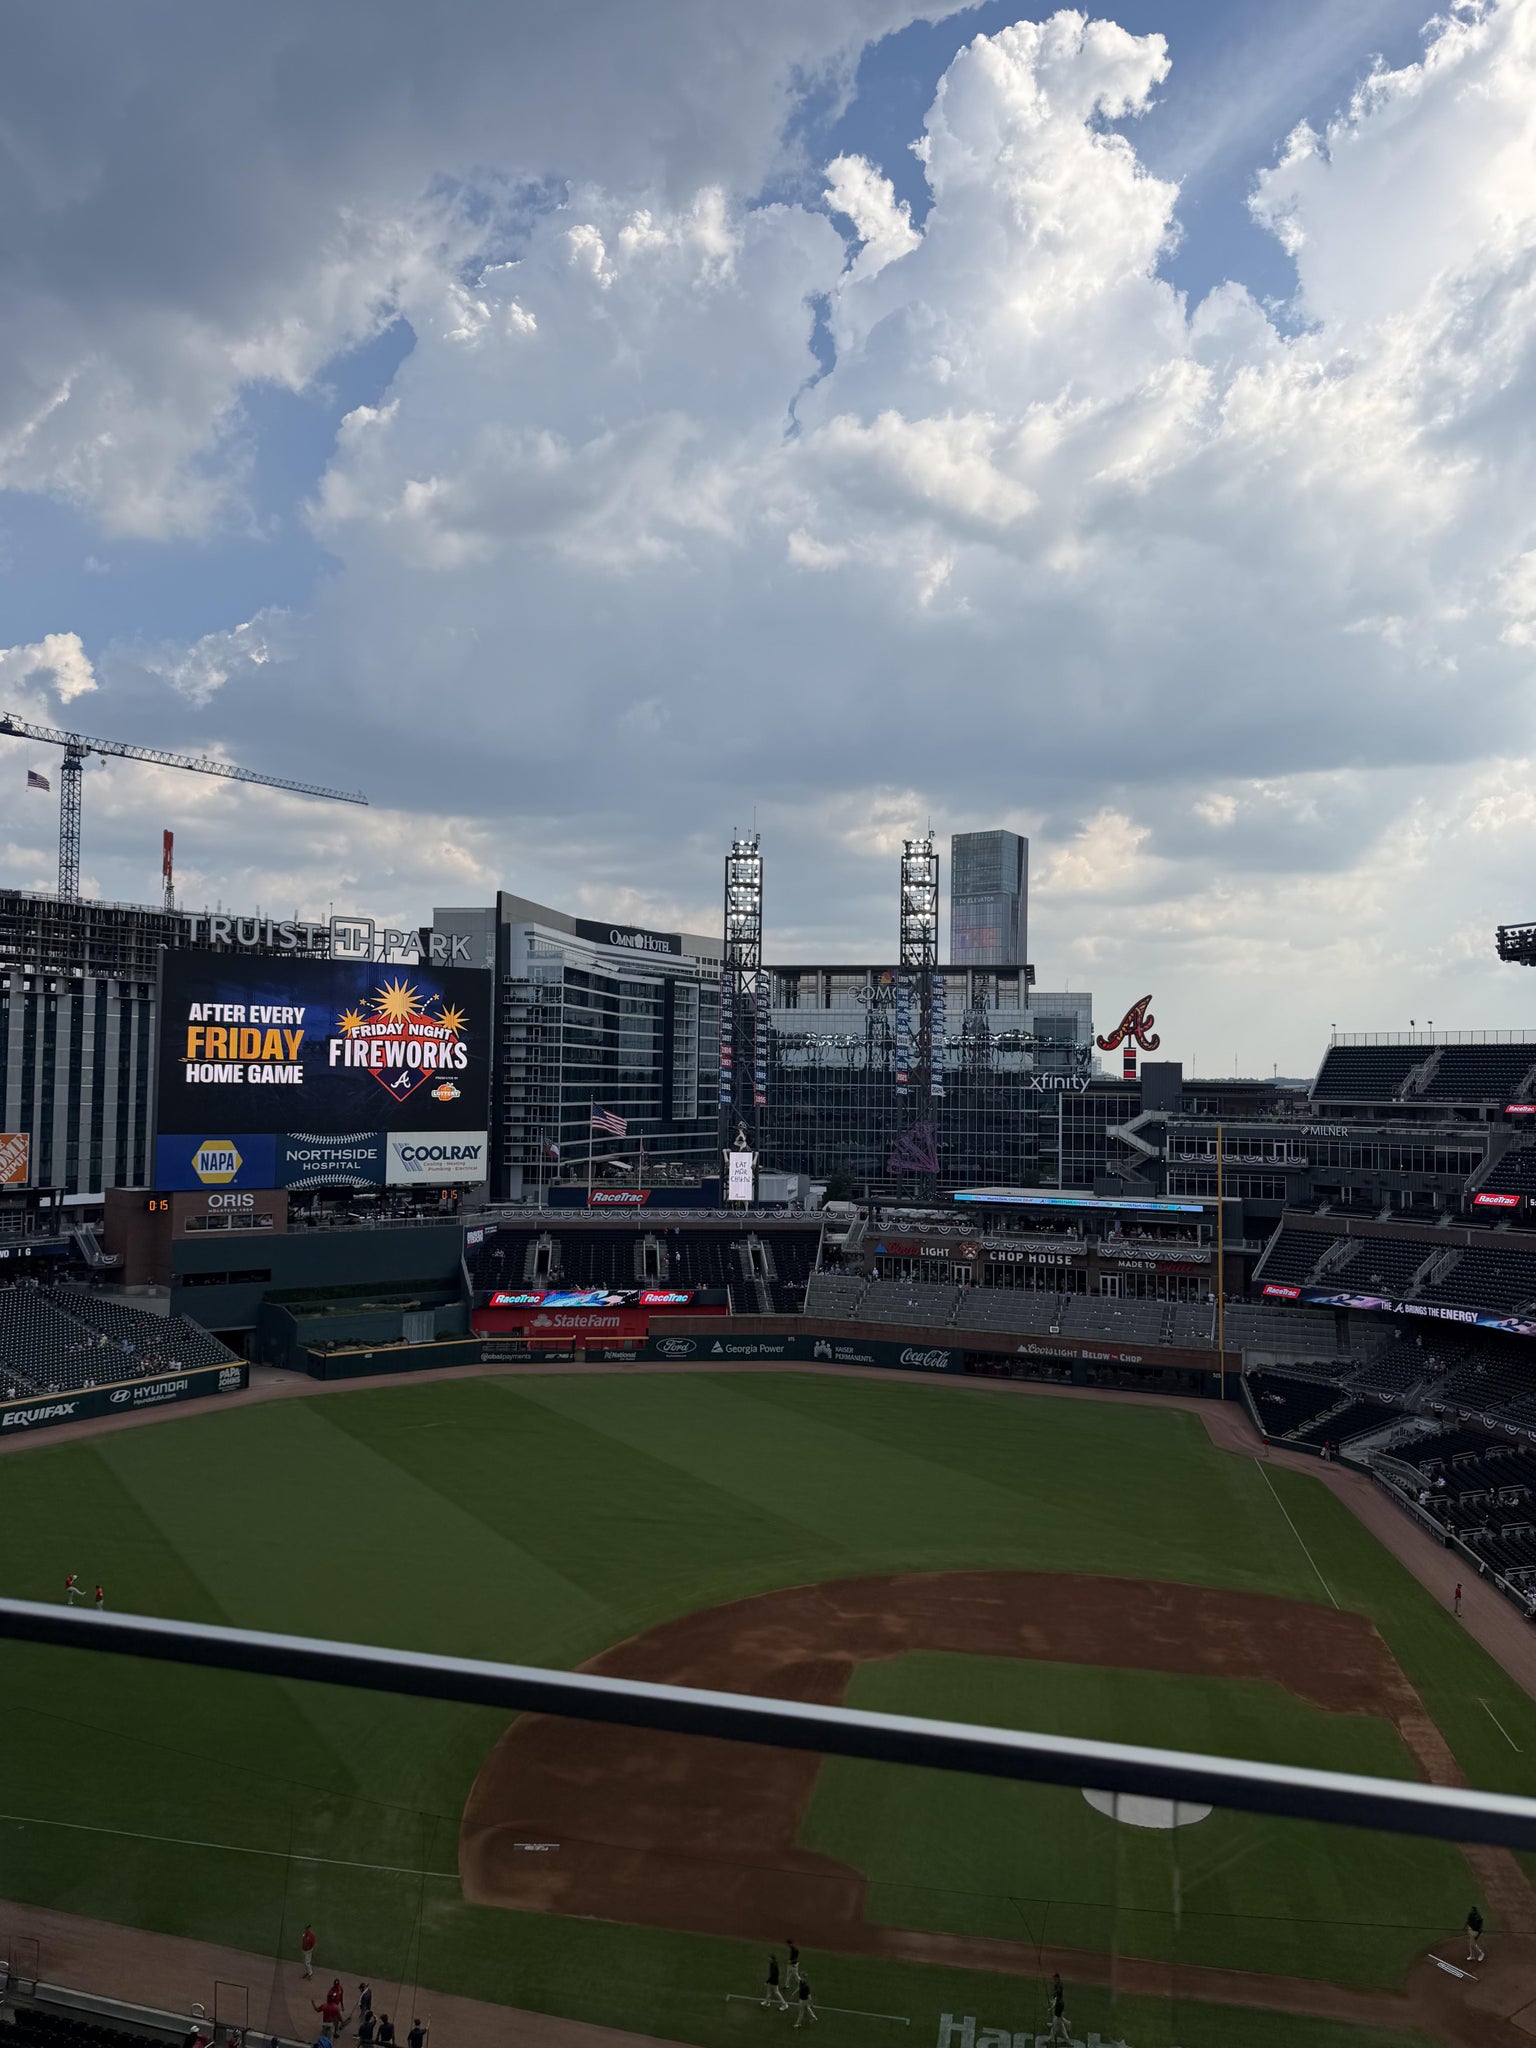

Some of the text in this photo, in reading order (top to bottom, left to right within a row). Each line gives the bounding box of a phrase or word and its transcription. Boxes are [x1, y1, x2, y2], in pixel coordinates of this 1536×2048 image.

[183, 914, 473, 961] TRUIST PARK
[644, 935, 671, 953] HOTEL
[189, 1003, 305, 1024] AFTER EVERY
[351, 1023, 453, 1041] FRIDAY NIGHT
[187, 1026, 304, 1060] FRIDAY
[329, 1038, 468, 1069] FIREWORKS
[186, 1063, 303, 1084] HOME GAME
[1029, 1072, 1091, 1094] xfinity
[1310, 1126, 1349, 1137] MILNER
[0, 1134, 28, 1171] OME
[286, 1149, 378, 1161] NORTHSIDE
[401, 1145, 483, 1161] COOLRAY
[200, 1152, 234, 1171] NAPA
[303, 1161, 361, 1170] HOSPITAL
[208, 1193, 254, 1208] ORIS
[592, 1192, 644, 1201] RaceTrac
[1479, 1195, 1516, 1204] RaceTrac
[920, 1247, 950, 1257] LIGHT
[990, 1250, 1073, 1266] CHOP HOUSE
[1118, 1260, 1142, 1269] MADE
[1144, 1261, 1156, 1270] TO
[495, 1294, 541, 1304] RaceTrac
[645, 1293, 689, 1303] RaceTrac
[1266, 1286, 1297, 1297] RaceTrac
[1381, 1301, 1392, 1311] THE
[1405, 1304, 1427, 1316] BRINGS
[1427, 1307, 1440, 1318] THE
[1440, 1308, 1479, 1323] ENERGY
[663, 1339, 690, 1351] Ford
[725, 1343, 785, 1354] Georgia Power
[835, 1346, 855, 1354] KAISER
[835, 1353, 872, 1363] PERMANENTE
[900, 1347, 951, 1368] Coca-Cola
[1027, 1343, 1053, 1355] Coors
[1053, 1348, 1077, 1358] LIGHT
[1082, 1349, 1110, 1361] BELOW
[1119, 1353, 1143, 1363] CHOP
[219, 1367, 241, 1379] PAPA
[134, 1379, 188, 1398] HYUNDAI
[218, 1375, 241, 1387] JOHNS
[2, 1402, 76, 1426] EQUIFAX
